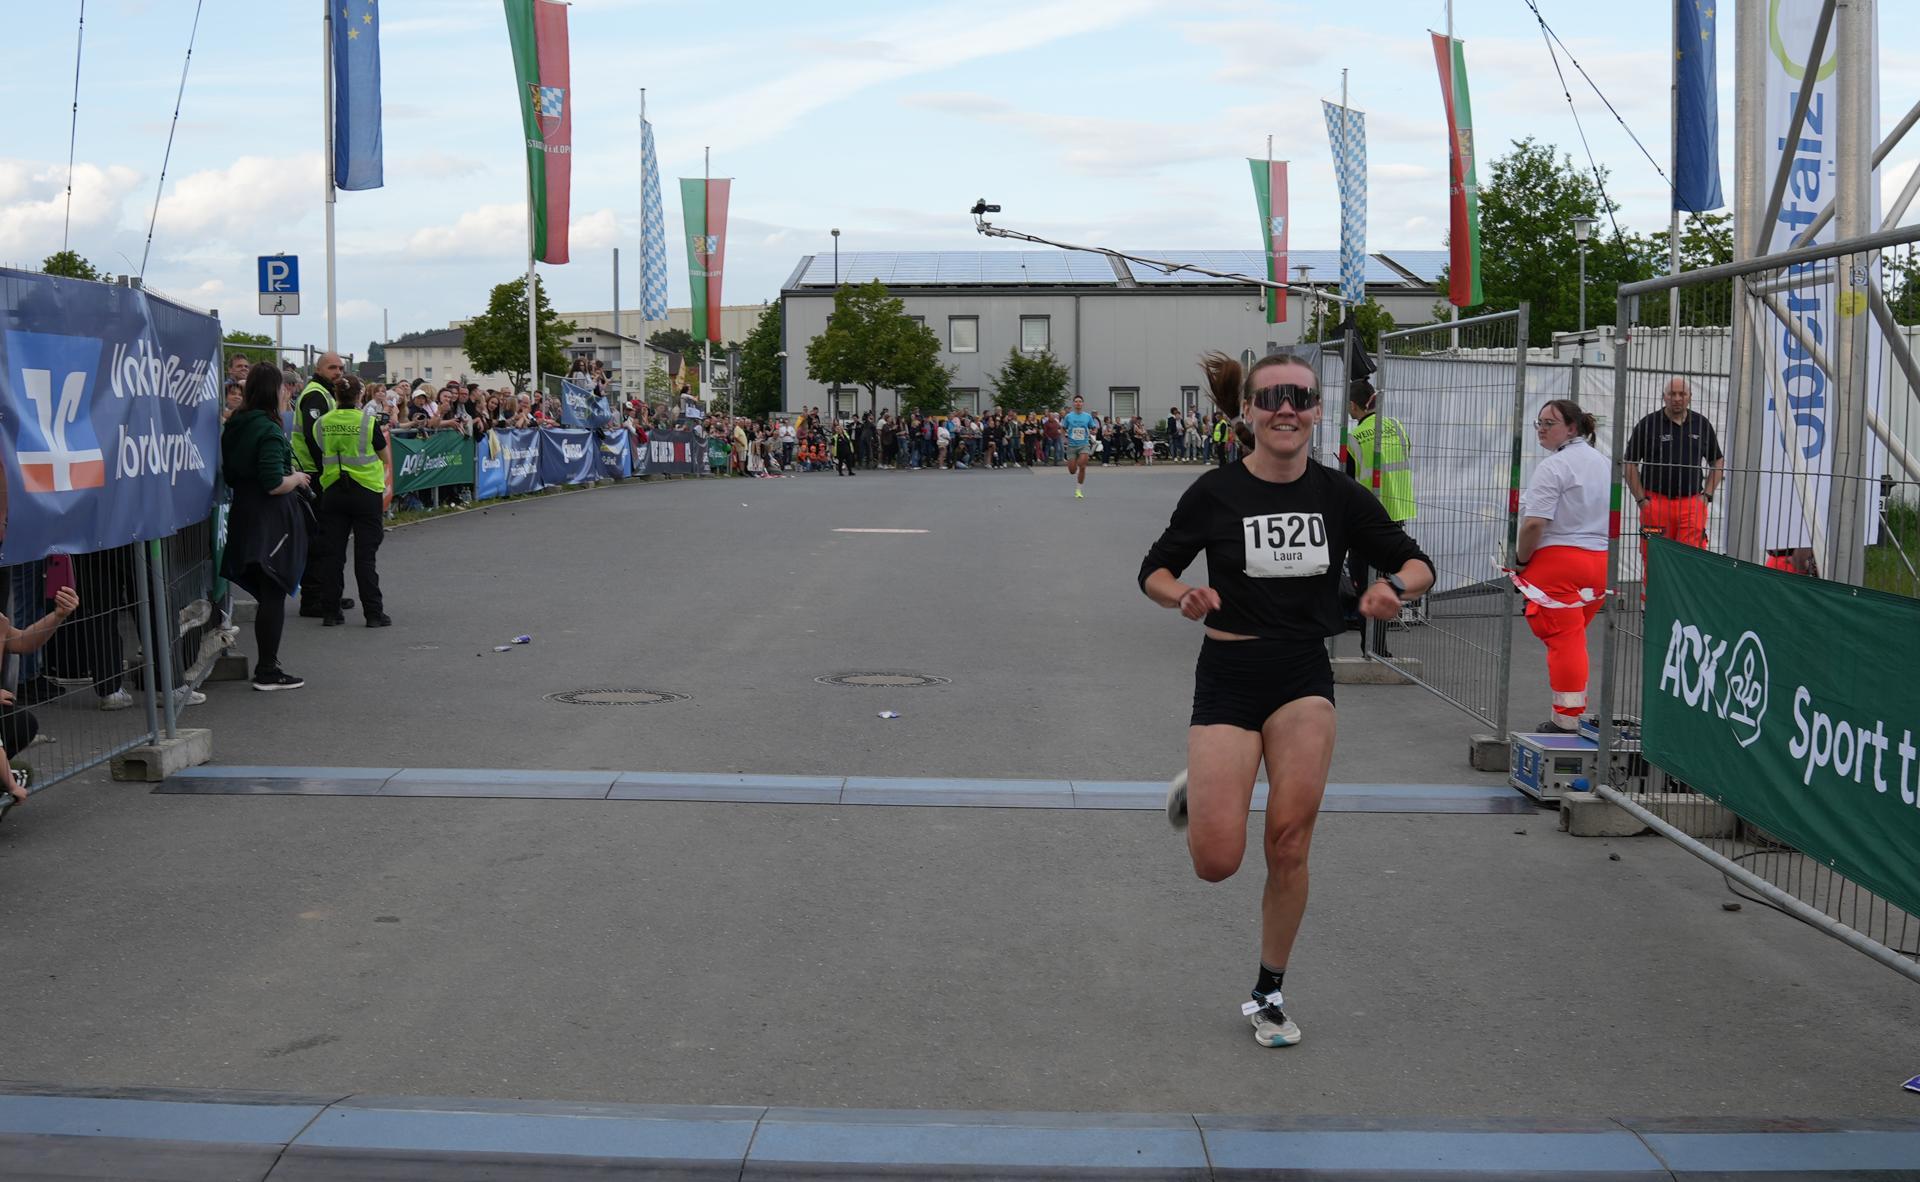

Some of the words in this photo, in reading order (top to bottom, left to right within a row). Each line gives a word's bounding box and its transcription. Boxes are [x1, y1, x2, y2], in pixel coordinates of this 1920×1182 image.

[267, 261, 289, 291] P
[1246, 515, 1326, 549] 1520
[1274, 551, 1303, 561] Laura
[1789, 686, 1889, 793] Sport
